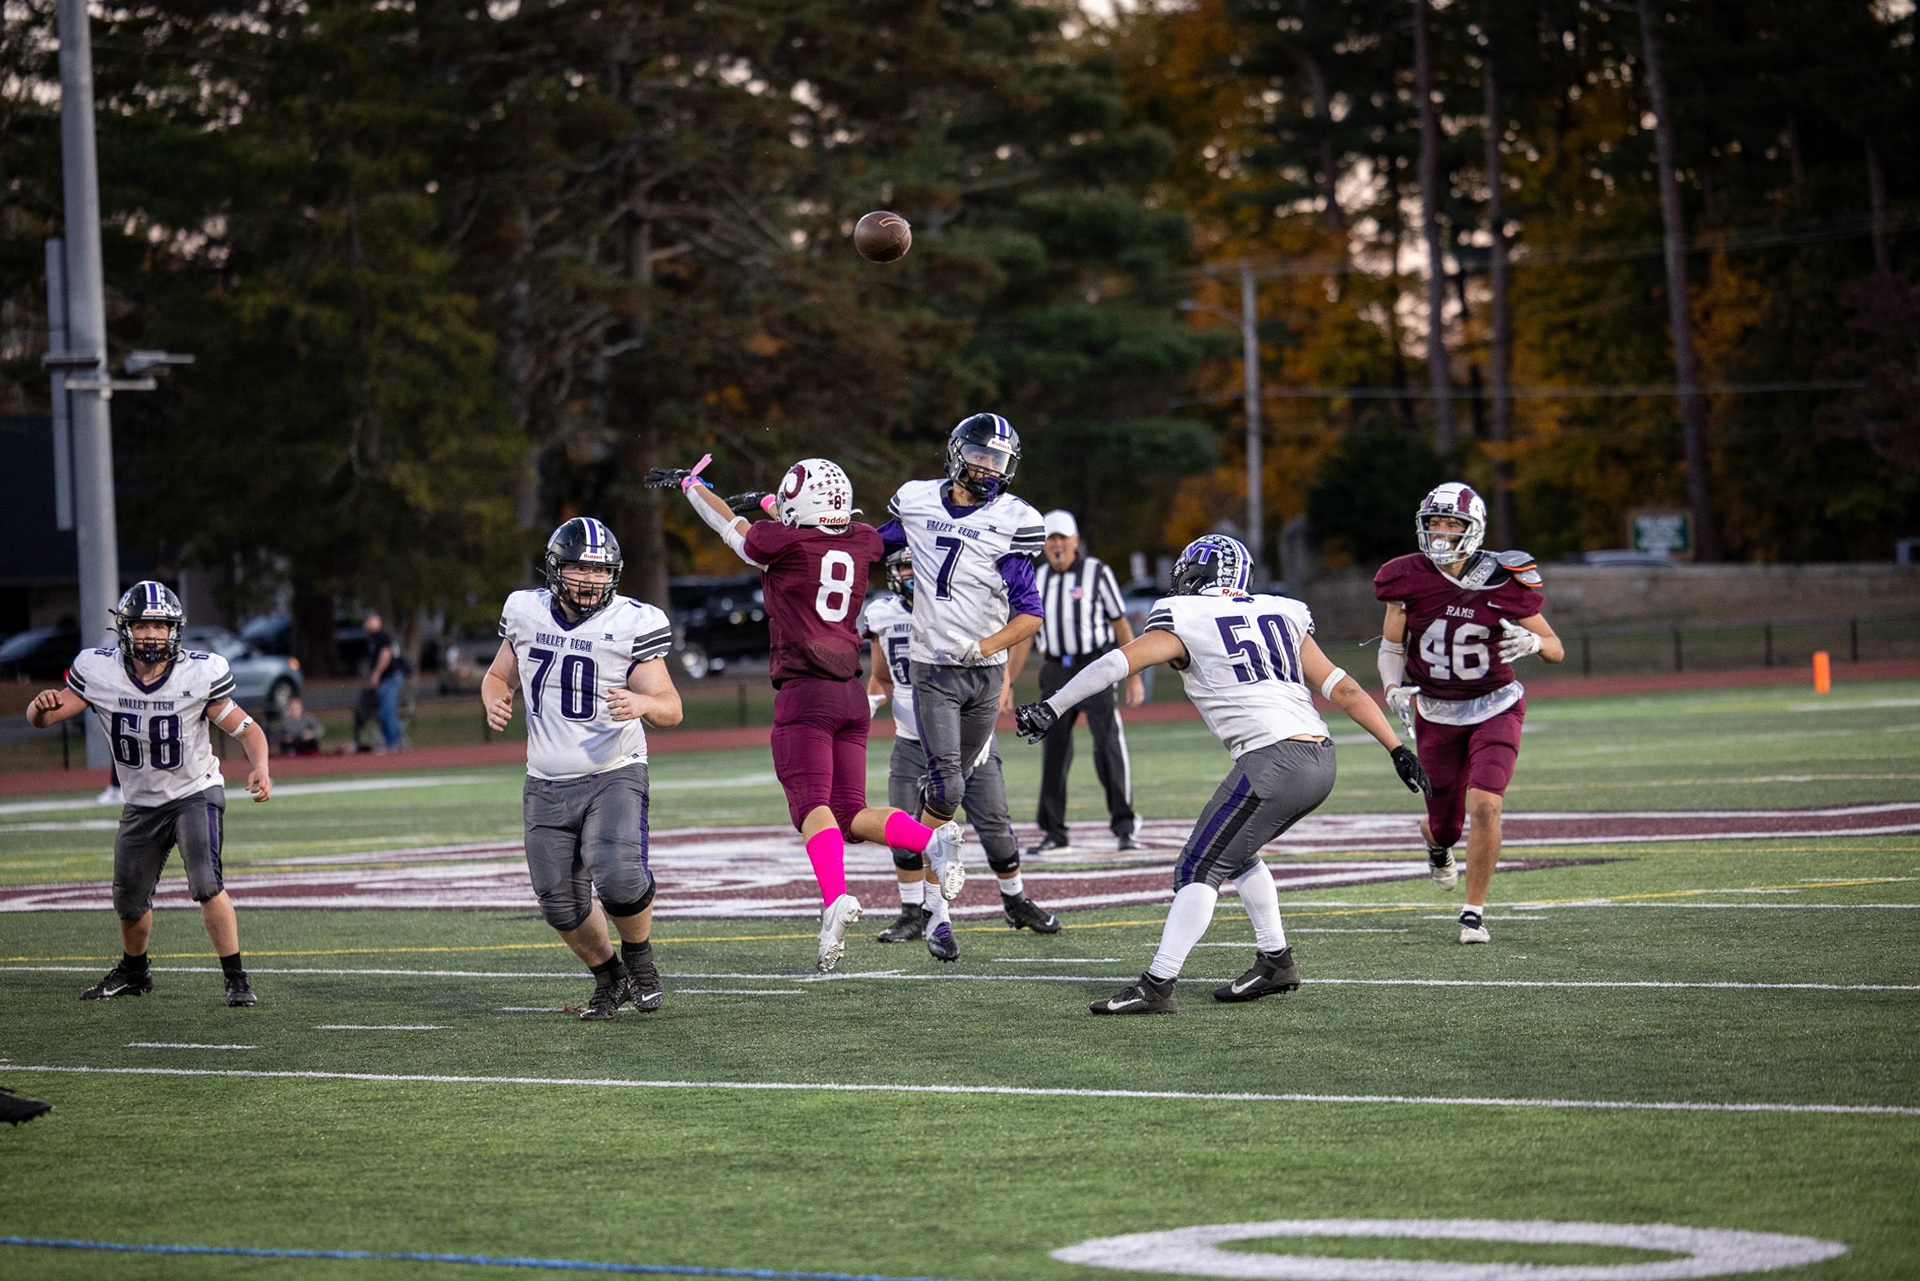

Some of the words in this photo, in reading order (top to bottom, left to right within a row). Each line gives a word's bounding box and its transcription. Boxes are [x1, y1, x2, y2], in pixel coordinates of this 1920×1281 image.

[834, 495, 842, 510] 8
[815, 549, 854, 623] 8
[935, 536, 964, 601] 7
[535, 632, 567, 648] VALLEY
[569, 638, 593, 653] TECH
[1445, 605, 1475, 619] RAMS
[1215, 614, 1303, 684] 50
[1419, 618, 1491, 681] 46
[118, 697, 149, 710] VALLEY
[153, 701, 174, 711] TECH
[527, 647, 599, 723] 70
[111, 712, 184, 771] 68
